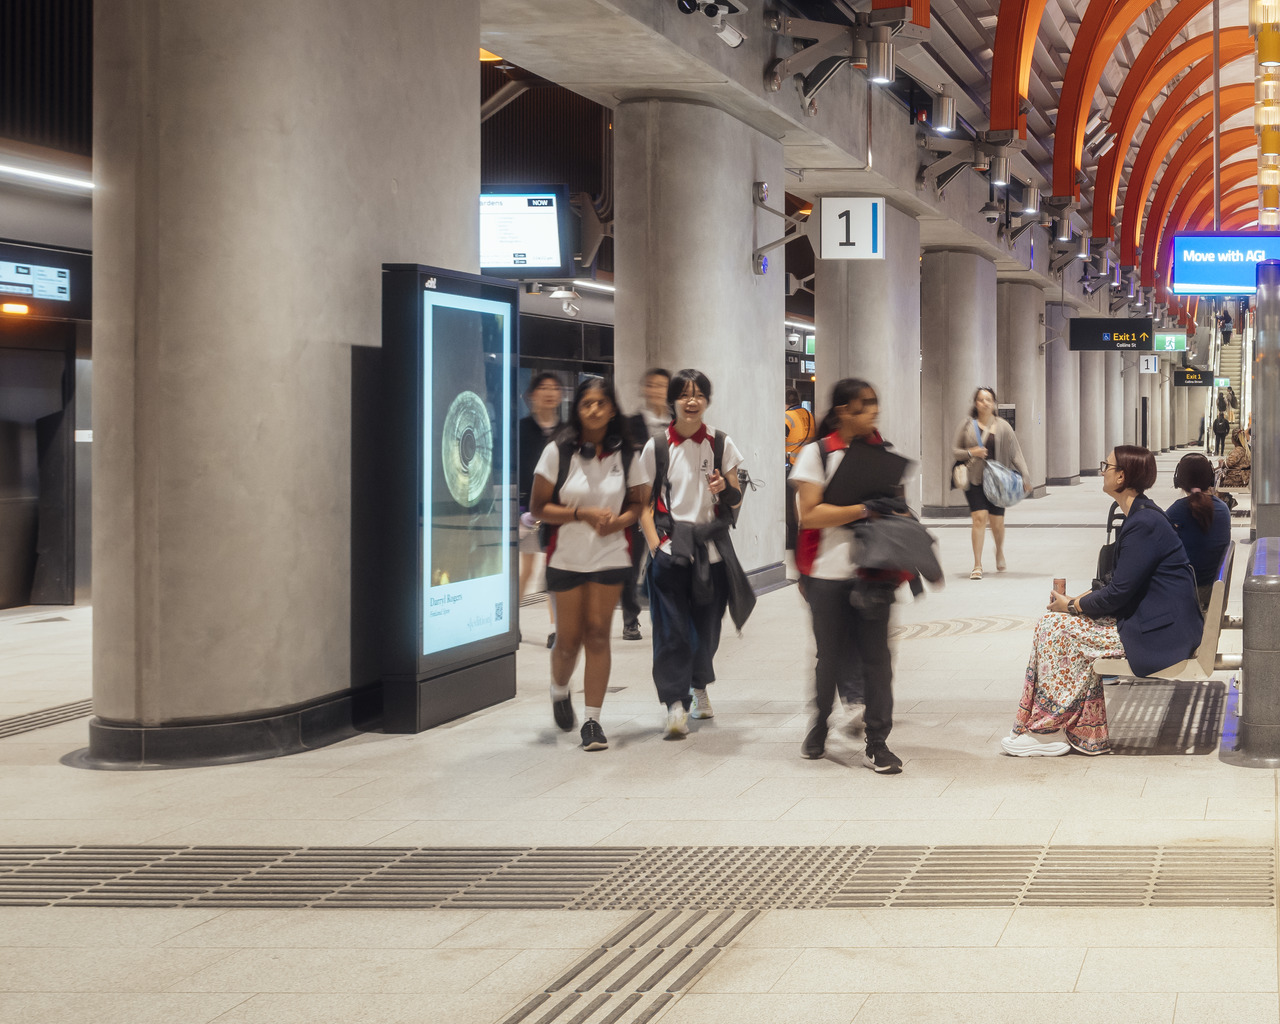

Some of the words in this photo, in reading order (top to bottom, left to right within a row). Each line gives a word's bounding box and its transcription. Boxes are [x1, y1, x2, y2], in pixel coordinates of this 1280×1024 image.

[837, 209, 856, 247] 1
[1183, 250, 1215, 262] Move
[1217, 250, 1243, 262] with
[1245, 250, 1266, 262] AGL
[1113, 332, 1130, 341] Exit
[1131, 332, 1137, 341] 1
[1144, 358, 1150, 370] 1
